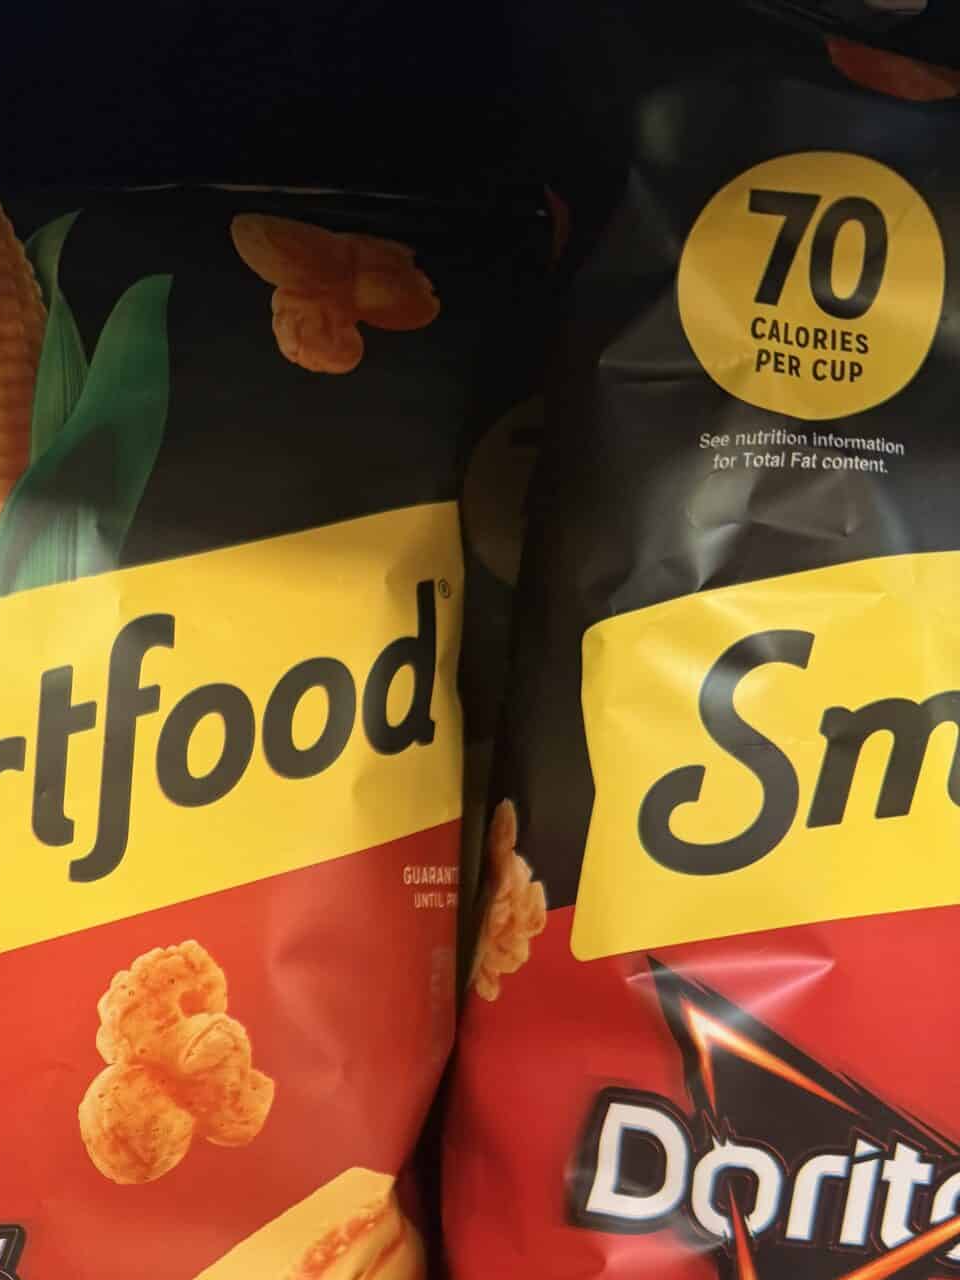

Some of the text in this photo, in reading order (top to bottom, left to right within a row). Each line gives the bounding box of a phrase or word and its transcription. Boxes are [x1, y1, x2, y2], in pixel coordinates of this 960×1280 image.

[748, 189, 888, 320] 70
[750, 317, 869, 354] CALORIES
[755, 349, 863, 383] PER CUP
[699, 429, 904, 455] See nutrition information
[712, 452, 889, 473] for Total Fat content.
